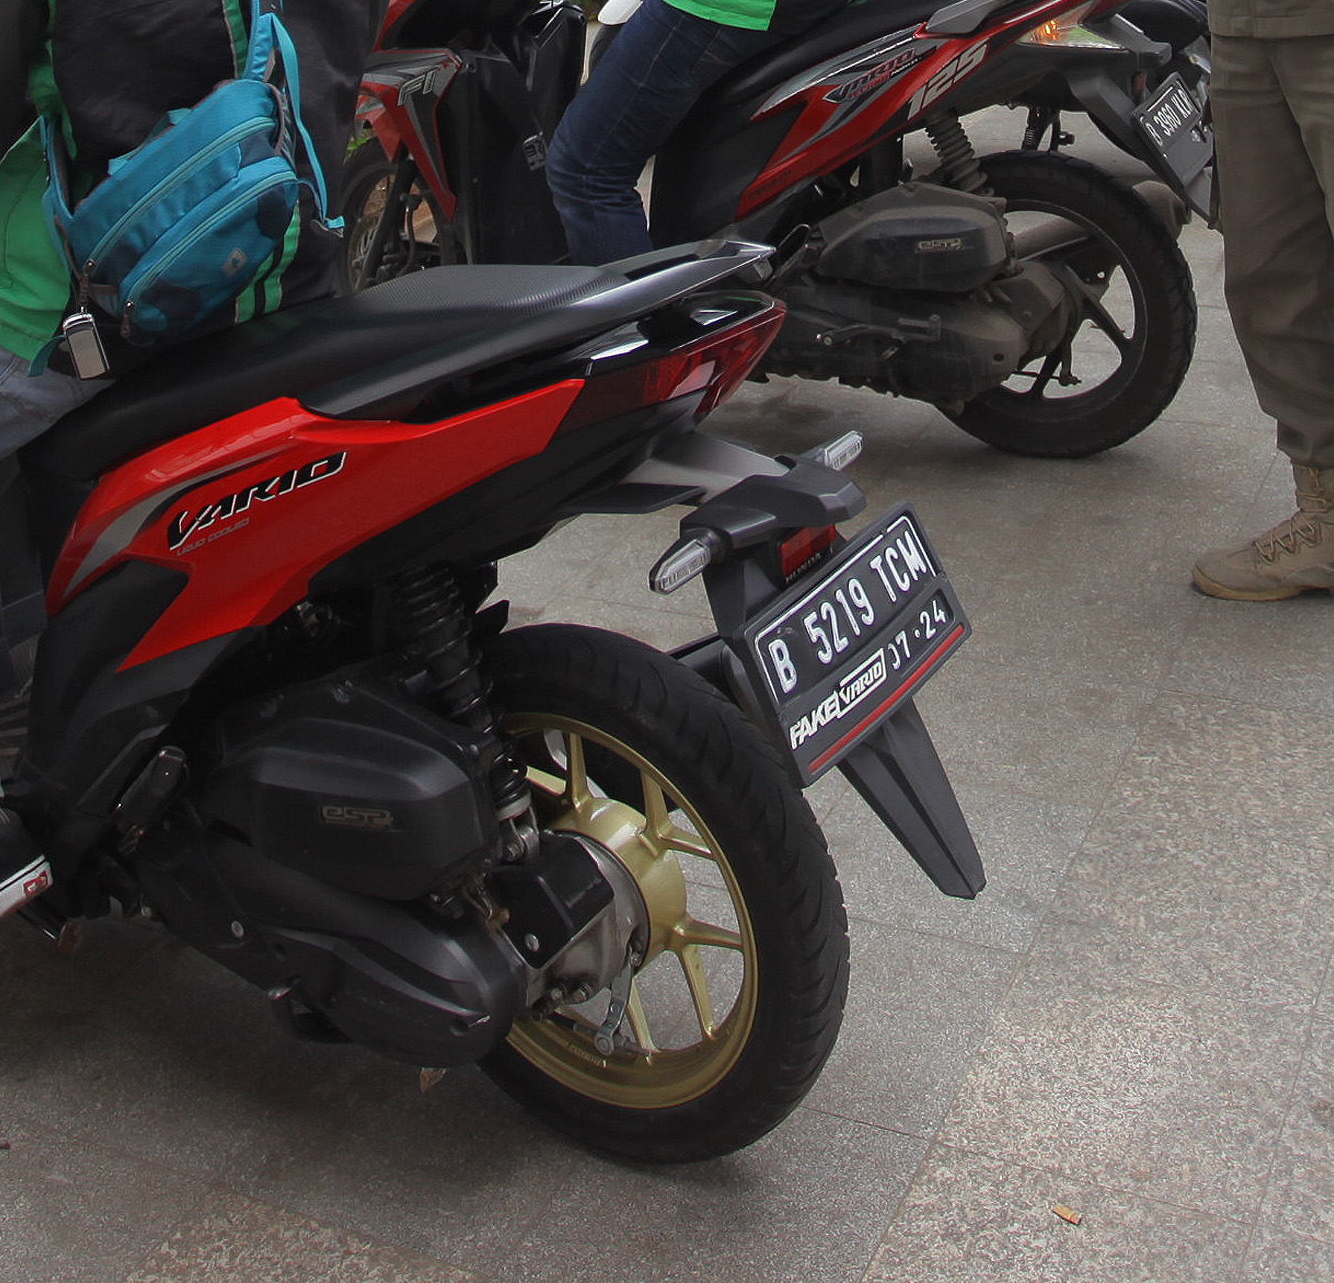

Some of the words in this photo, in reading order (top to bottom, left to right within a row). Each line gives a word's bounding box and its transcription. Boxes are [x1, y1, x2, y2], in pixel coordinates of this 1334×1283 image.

[397, 69, 436, 107] FI
[907, 38, 989, 120] 125
[168, 451, 347, 551] VARIO
[768, 639, 798, 694] B
[803, 578, 875, 664] 5219
[870, 531, 927, 602] TCM
[789, 691, 841, 750] FAKE
[839, 659, 883, 707] VARIO
